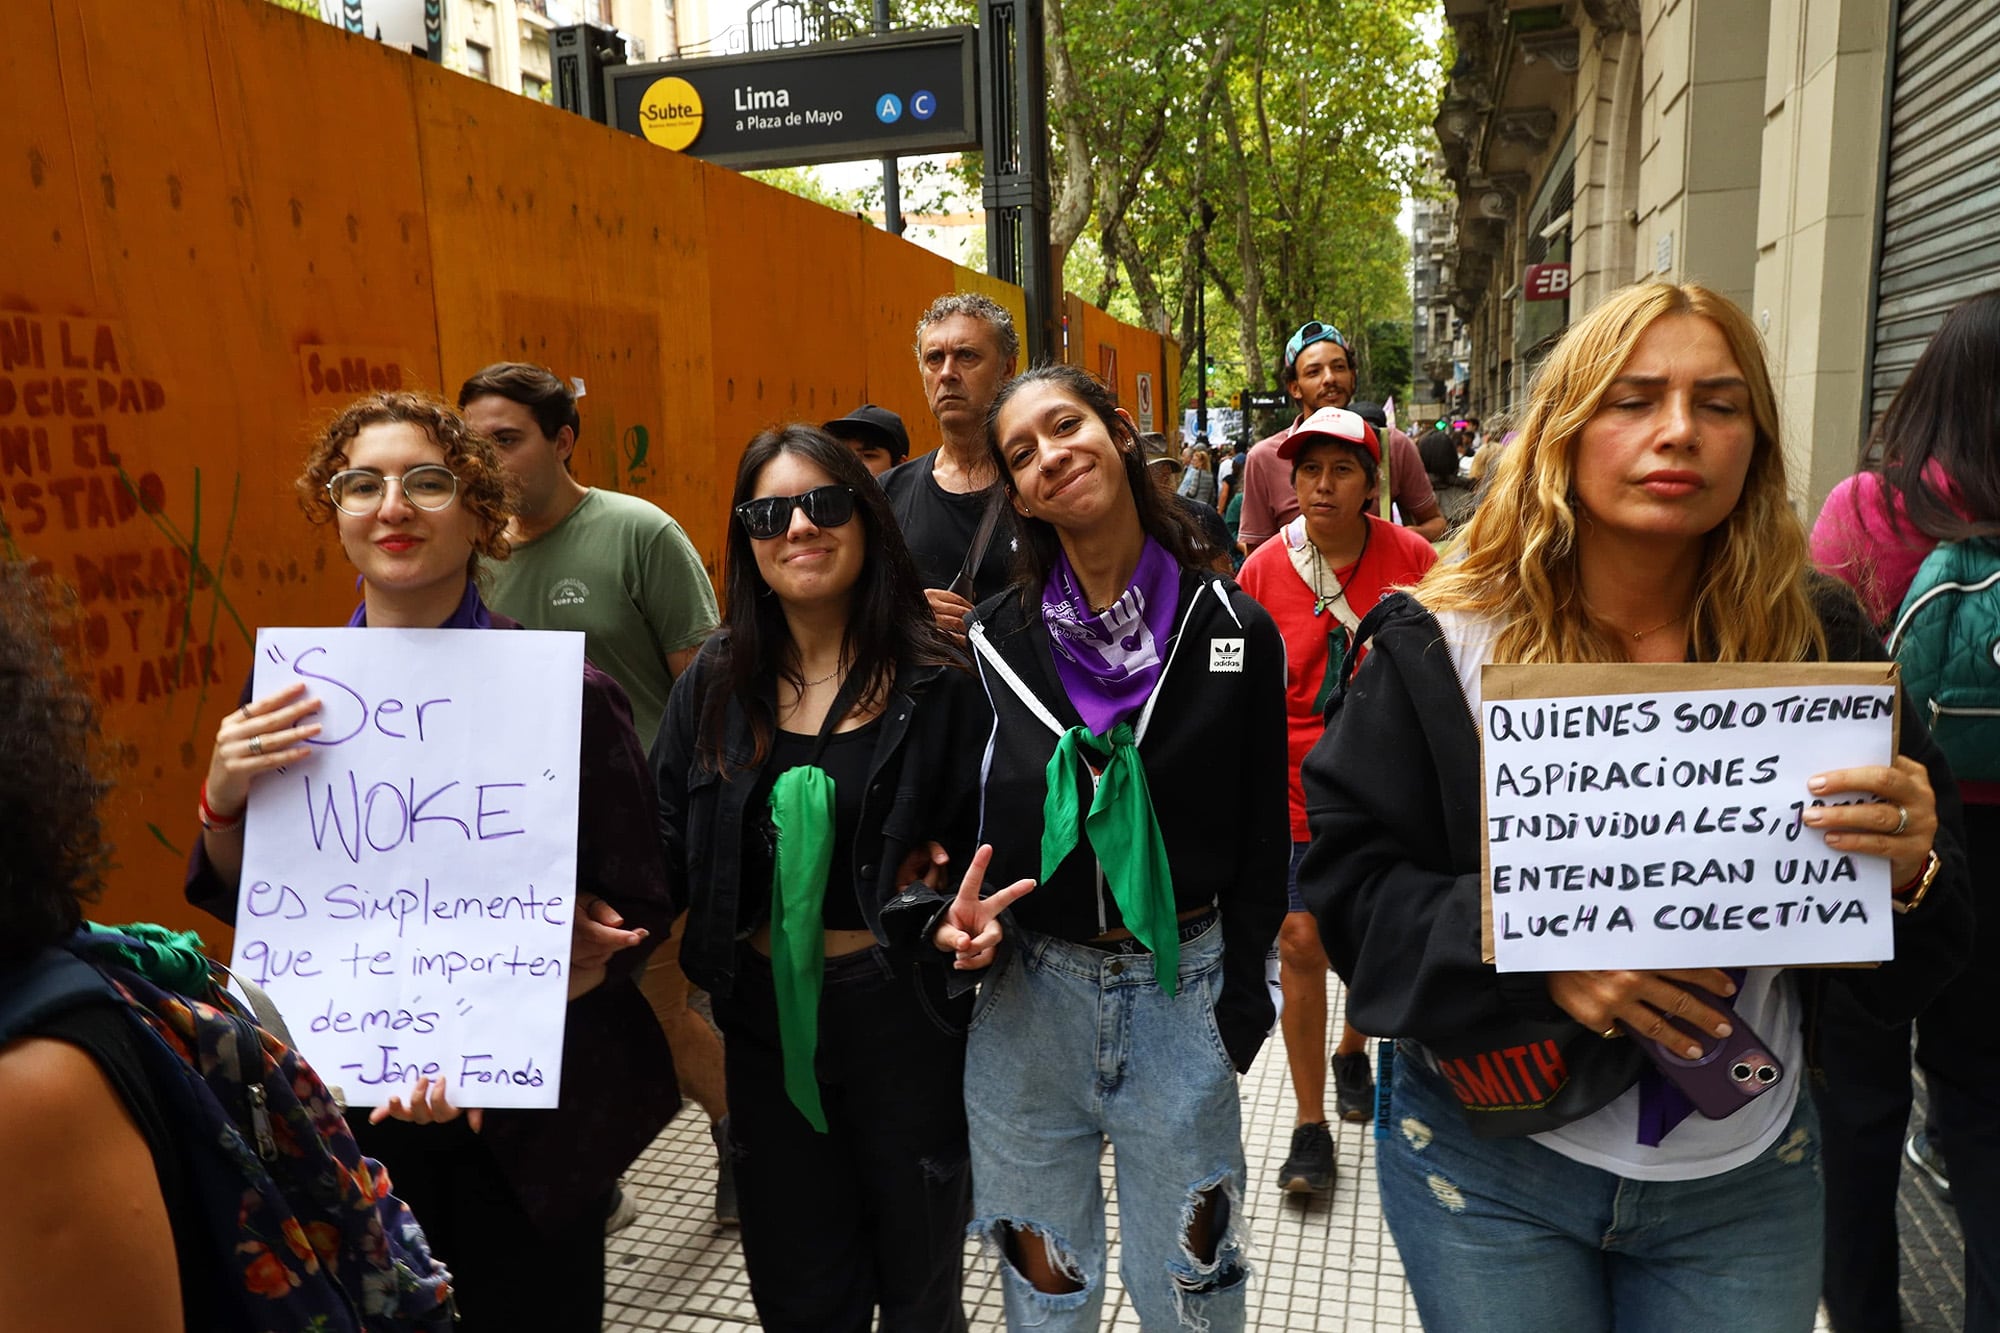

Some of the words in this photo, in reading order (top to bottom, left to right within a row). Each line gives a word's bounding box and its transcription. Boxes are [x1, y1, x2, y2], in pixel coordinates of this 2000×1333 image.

[646, 103, 697, 121] Subte
[734, 85, 790, 111] Lima
[882, 99, 896, 117] A
[914, 96, 929, 115] C
[735, 118, 744, 131] a
[747, 112, 782, 131] Plaza
[784, 111, 802, 127] de
[805, 107, 843, 129] Mayo
[60, 320, 120, 374] LA
[72, 424, 120, 470] EL
[1213, 659, 1241, 668] adidas
[1674, 700, 1767, 733] SOLO
[1493, 857, 1754, 893] ENTENDERAN
[1775, 855, 1858, 886] UNA
[1502, 904, 1635, 940] LUCHA
[241, 939, 322, 984] que
[341, 942, 395, 978] te
[412, 946, 562, 984] importen
[458, 1053, 545, 1088] Fonda
[1440, 1039, 1569, 1105] SMITH
[1378, 1091, 1391, 1131] JACKIE
